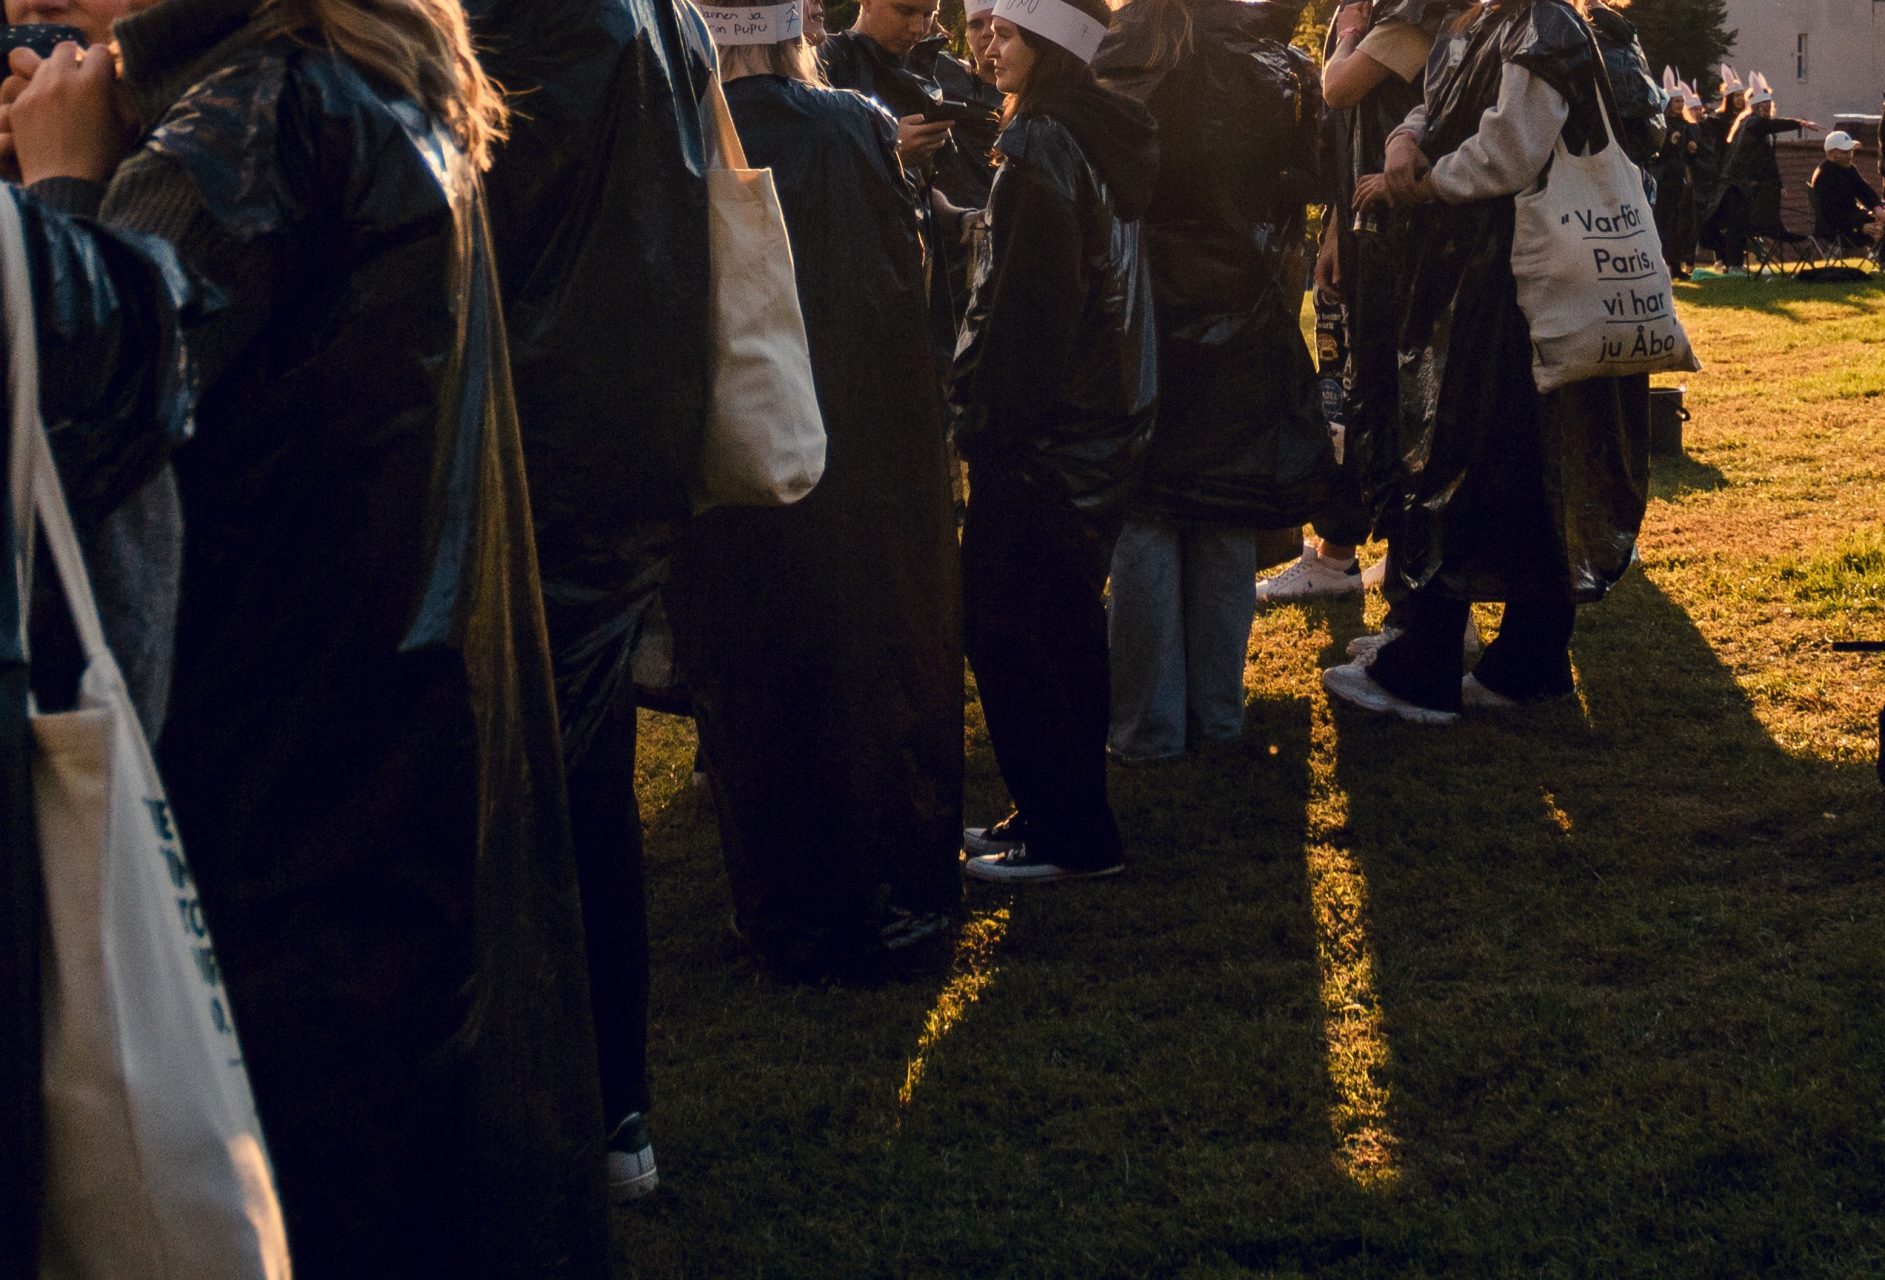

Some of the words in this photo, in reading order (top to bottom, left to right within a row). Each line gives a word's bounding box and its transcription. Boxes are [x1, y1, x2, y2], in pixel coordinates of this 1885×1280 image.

[1593, 248, 1654, 273] Paris,
[1603, 292, 1624, 316] vi
[1631, 289, 1664, 316] har
[1597, 336, 1622, 363] ju
